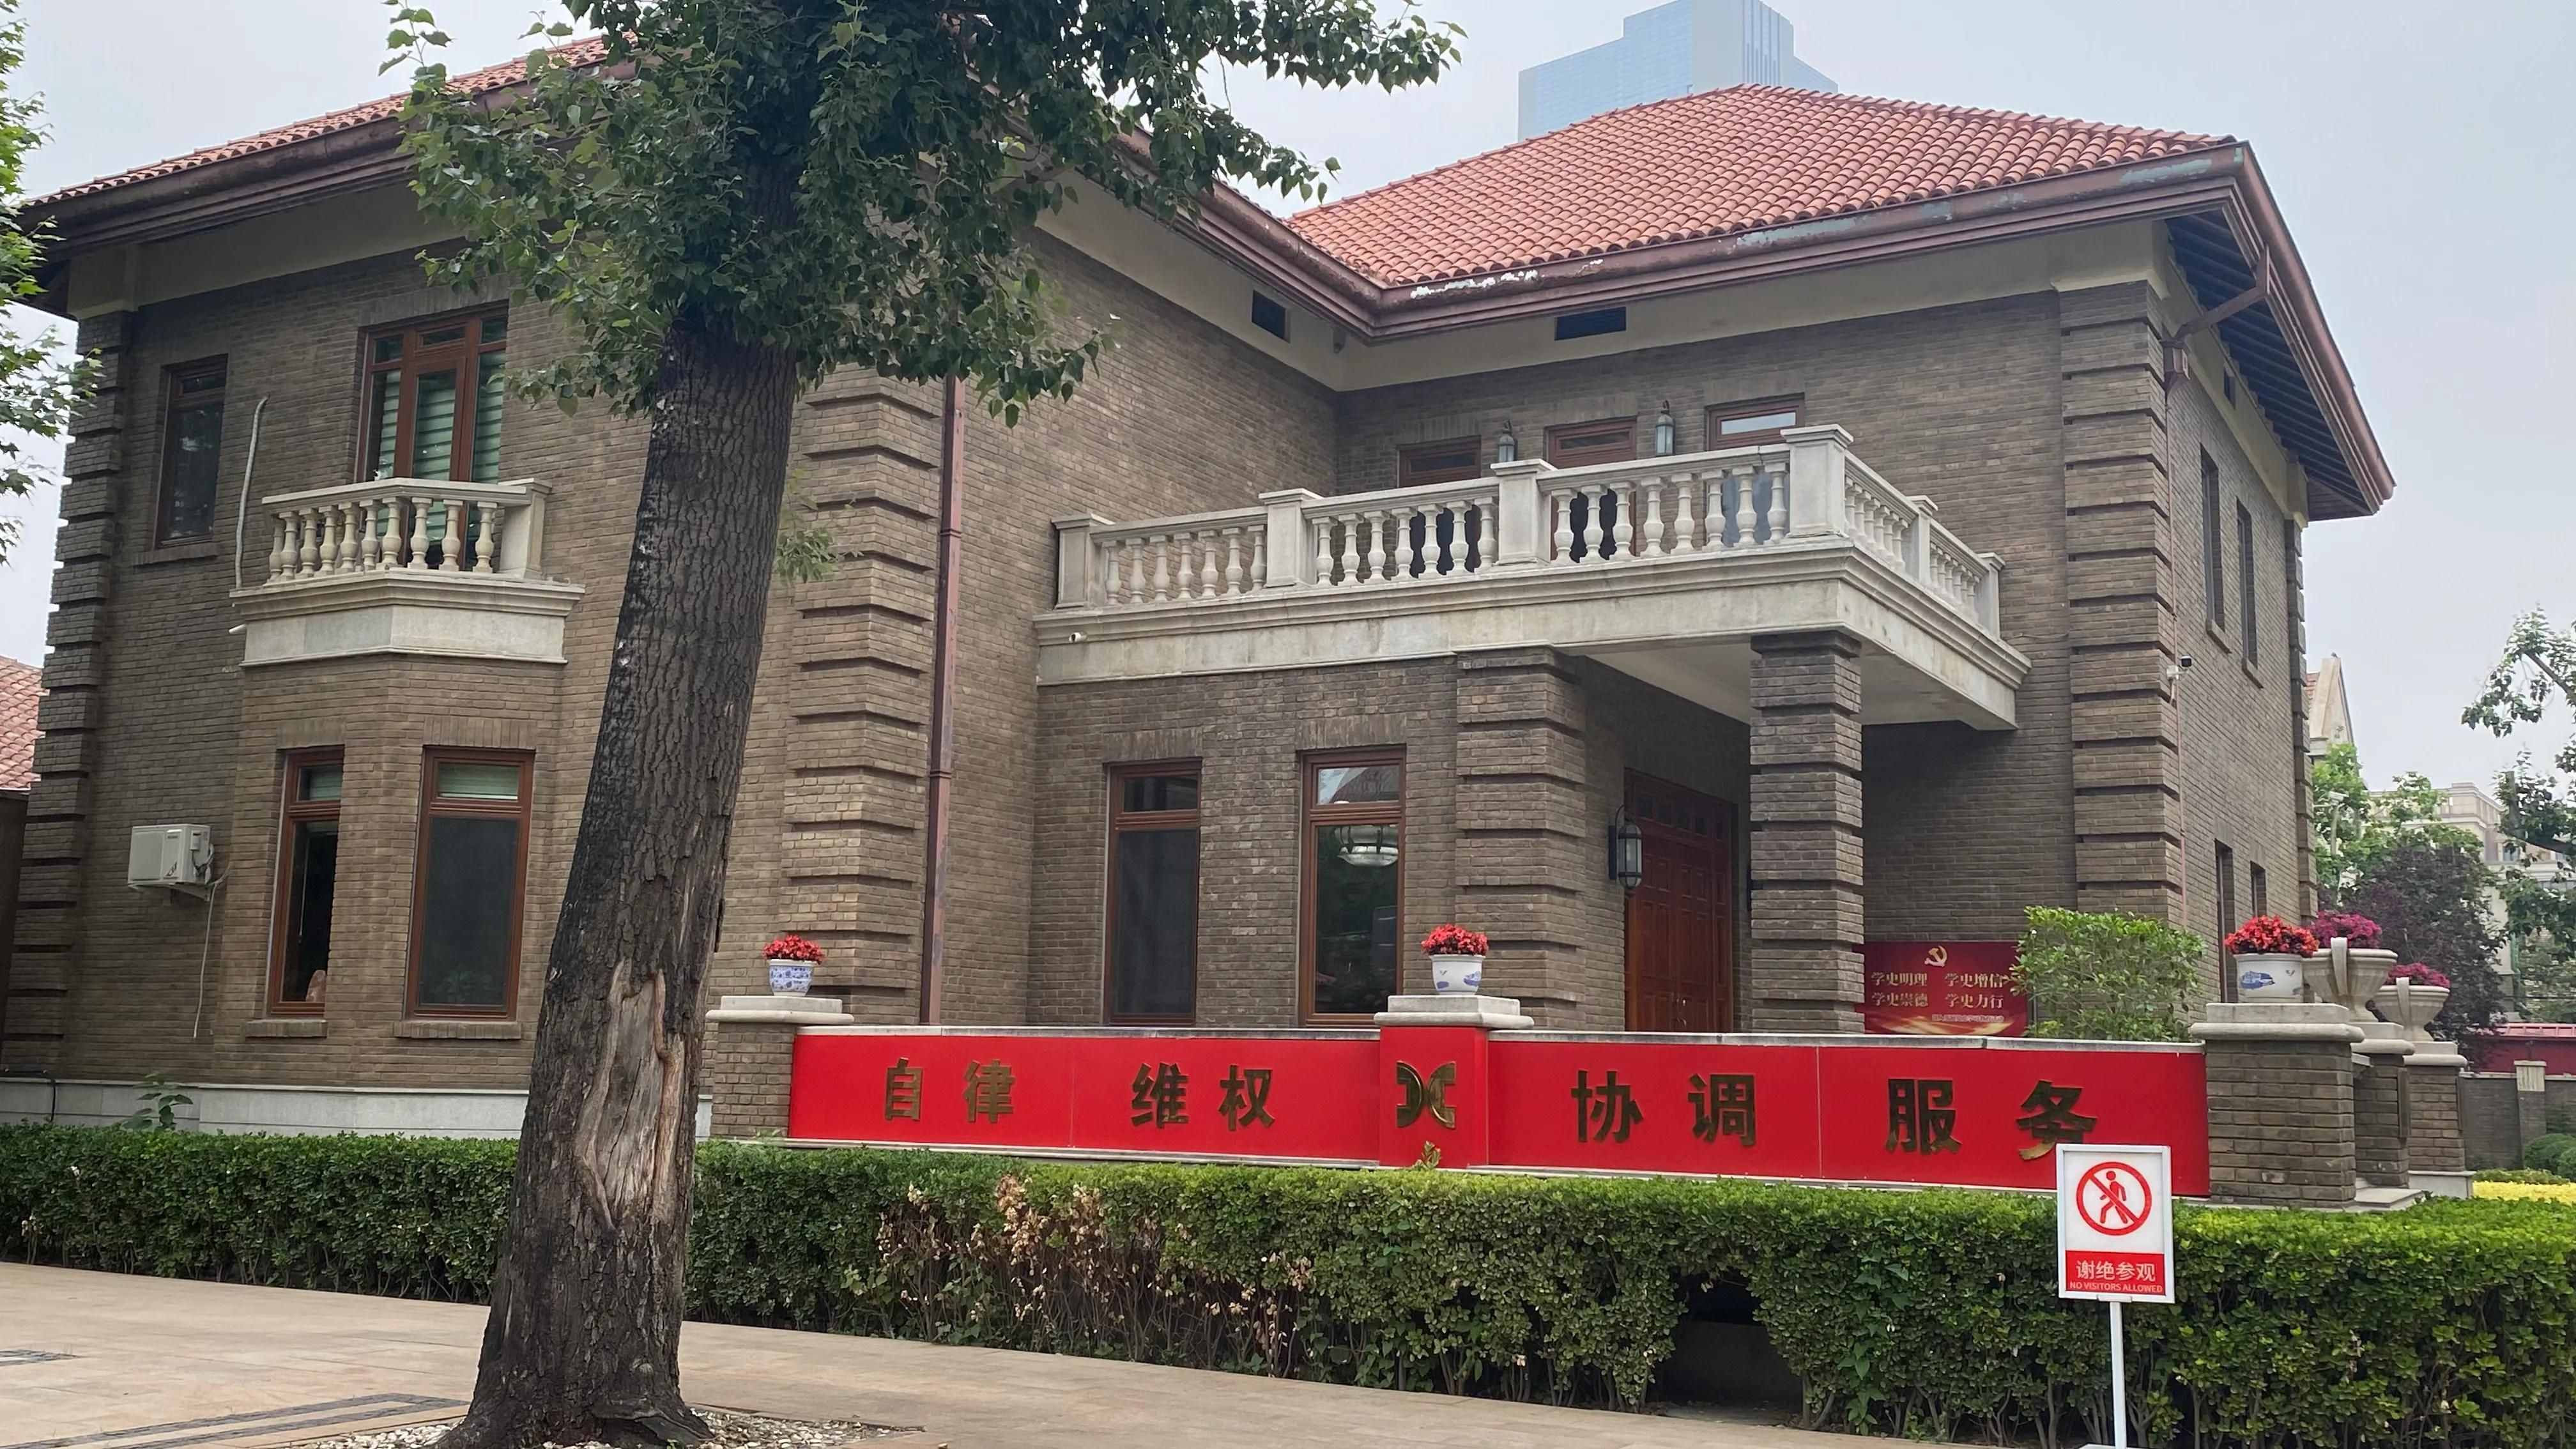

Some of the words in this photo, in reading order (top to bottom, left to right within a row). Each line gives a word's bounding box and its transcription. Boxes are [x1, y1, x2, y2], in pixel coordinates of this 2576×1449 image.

[1871, 972, 1928, 986] 学史明理
[1945, 972, 2004, 988] 学史增信
[1871, 992, 1928, 1007] 学史崇德
[1945, 993, 2004, 1009] 学史力行
[885, 1057, 1016, 1123] 自律
[1131, 1062, 1275, 1131] 维权
[1570, 1070, 1757, 1147] 协调
[1884, 1078, 2098, 1161] 服务
[2076, 1260, 2156, 1282] 谢绝参观
[2083, 1282, 2122, 1291] VISITORS
[2122, 1284, 2163, 1293] ALLOWED
